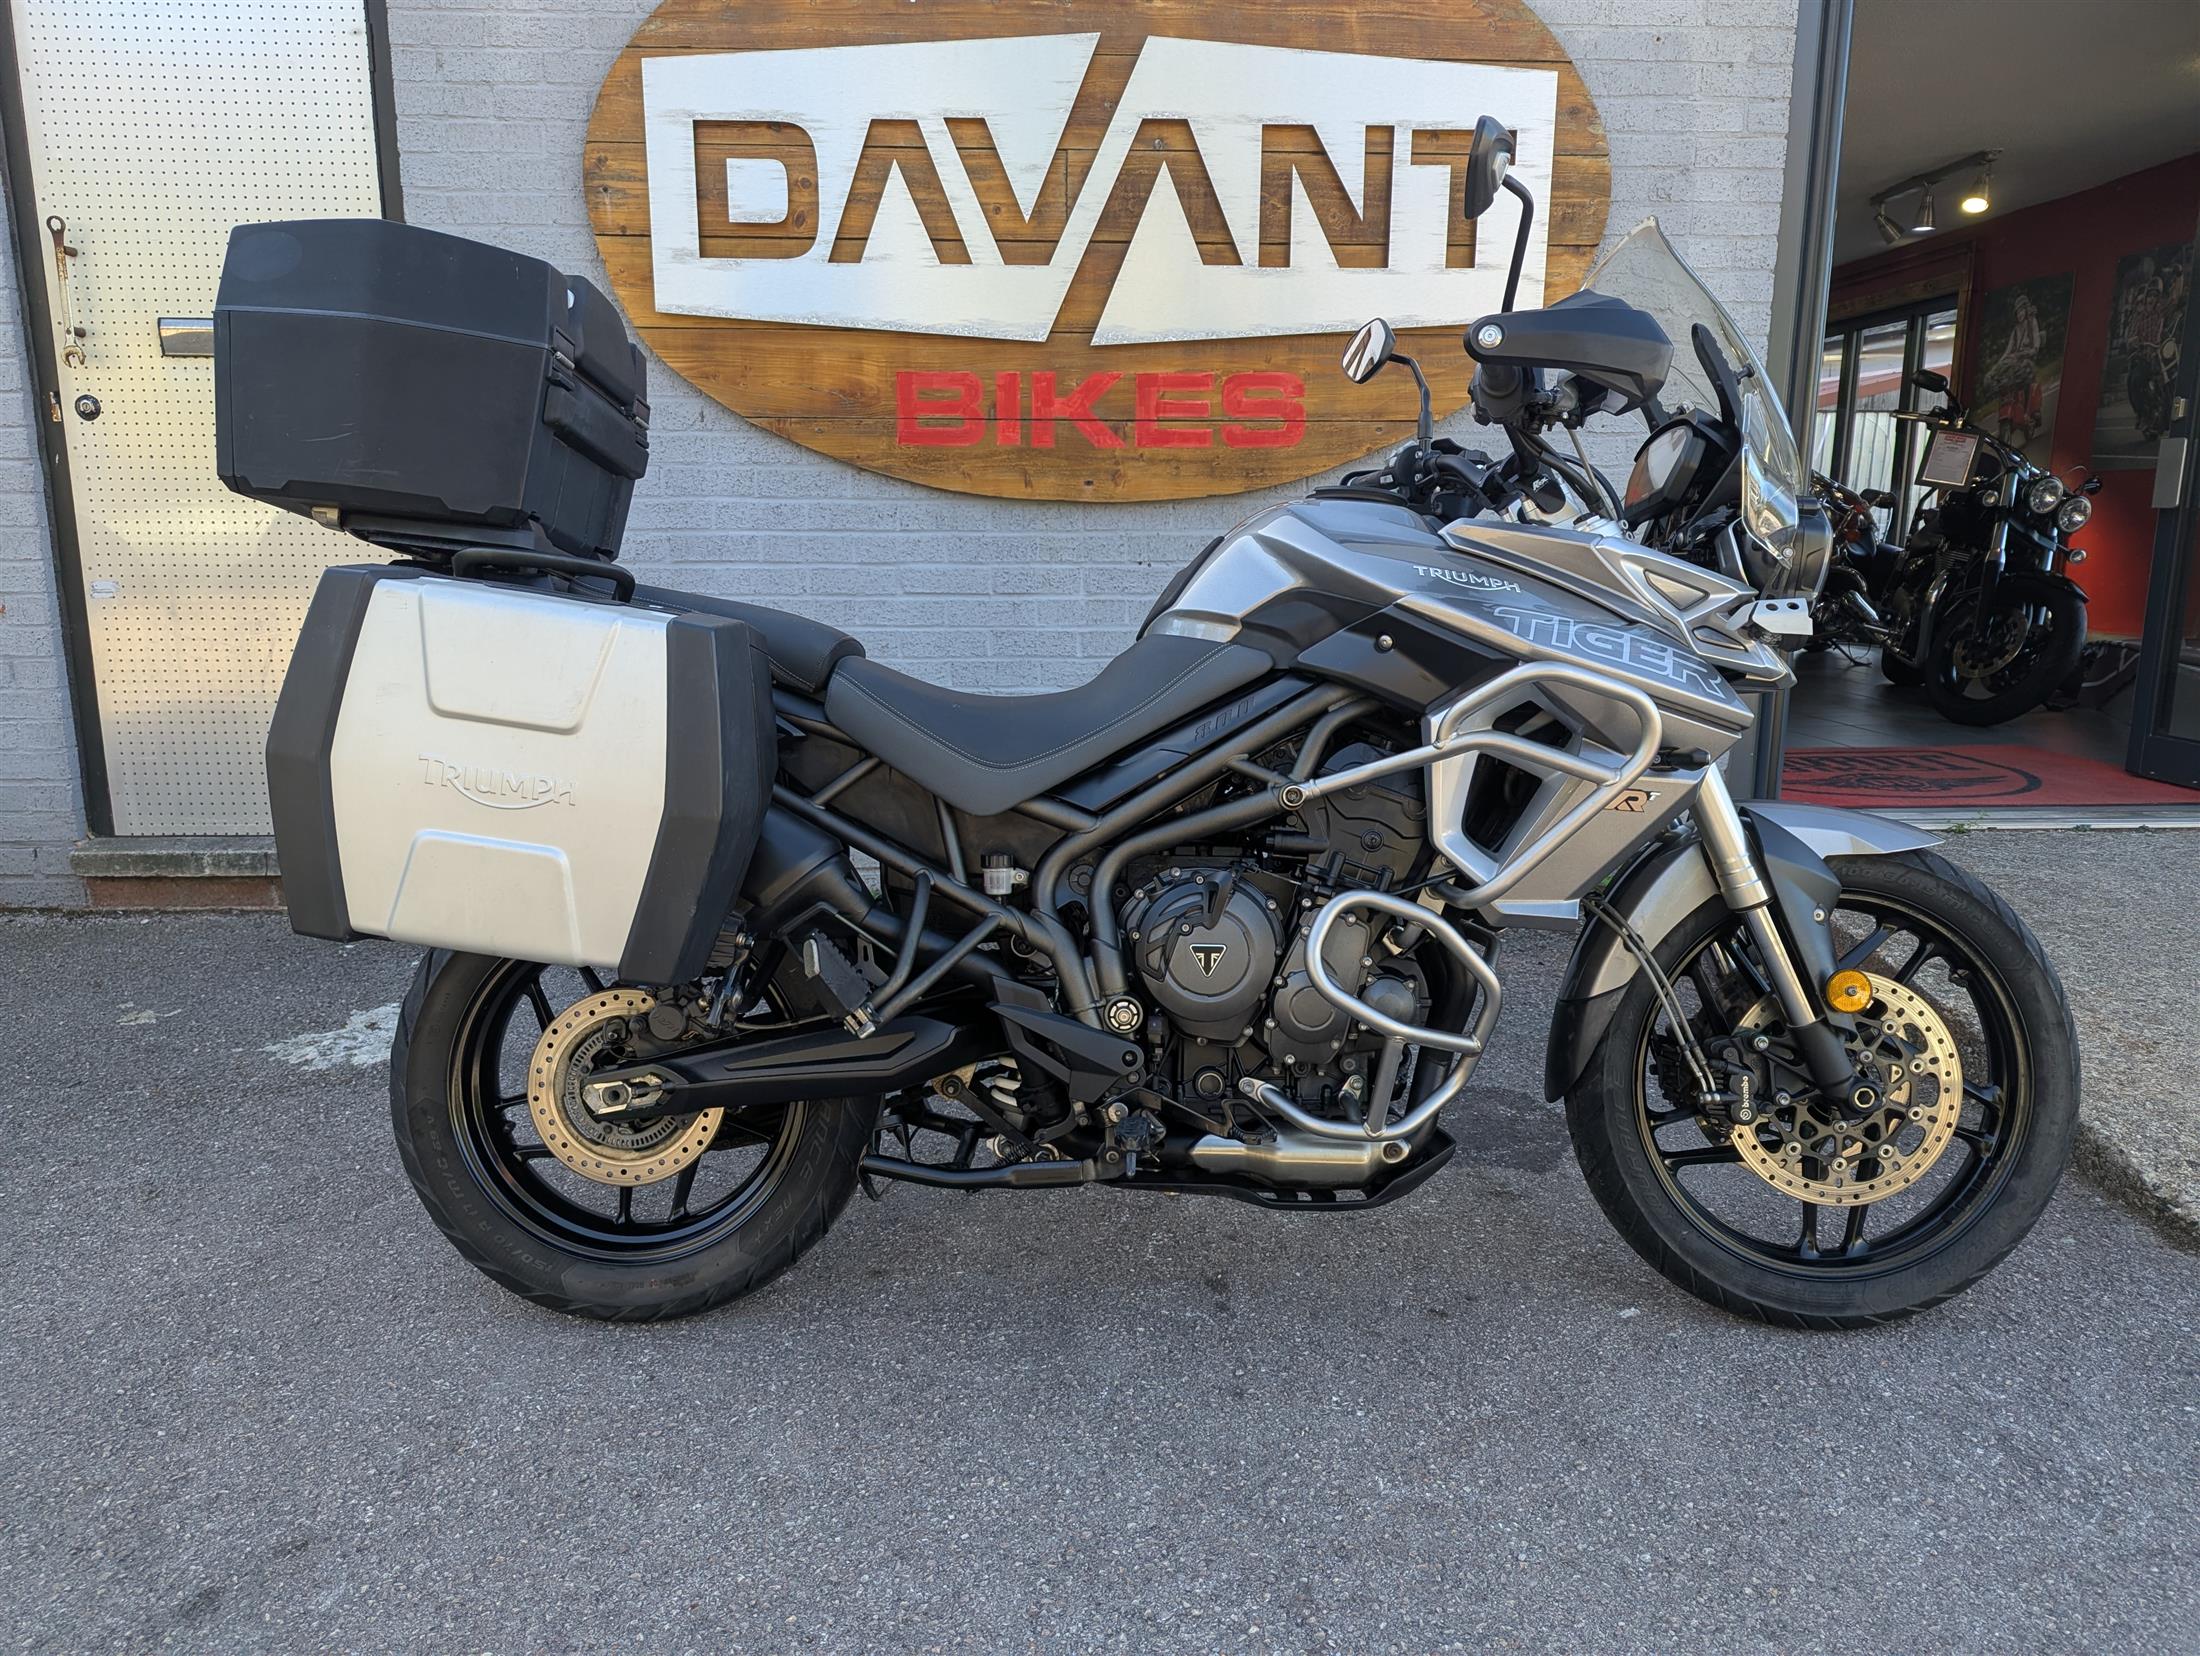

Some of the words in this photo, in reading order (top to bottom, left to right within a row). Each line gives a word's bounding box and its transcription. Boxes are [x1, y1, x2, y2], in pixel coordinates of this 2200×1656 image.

[693, 117, 1518, 268] DAVANT
[895, 371, 1306, 449] BIKES
[1413, 565, 1521, 593] TRIUMPH
[1493, 606, 1727, 699] TIGER
[417, 752, 576, 810] TRIUMPH
[1741, 1075, 1750, 1108] brembo
